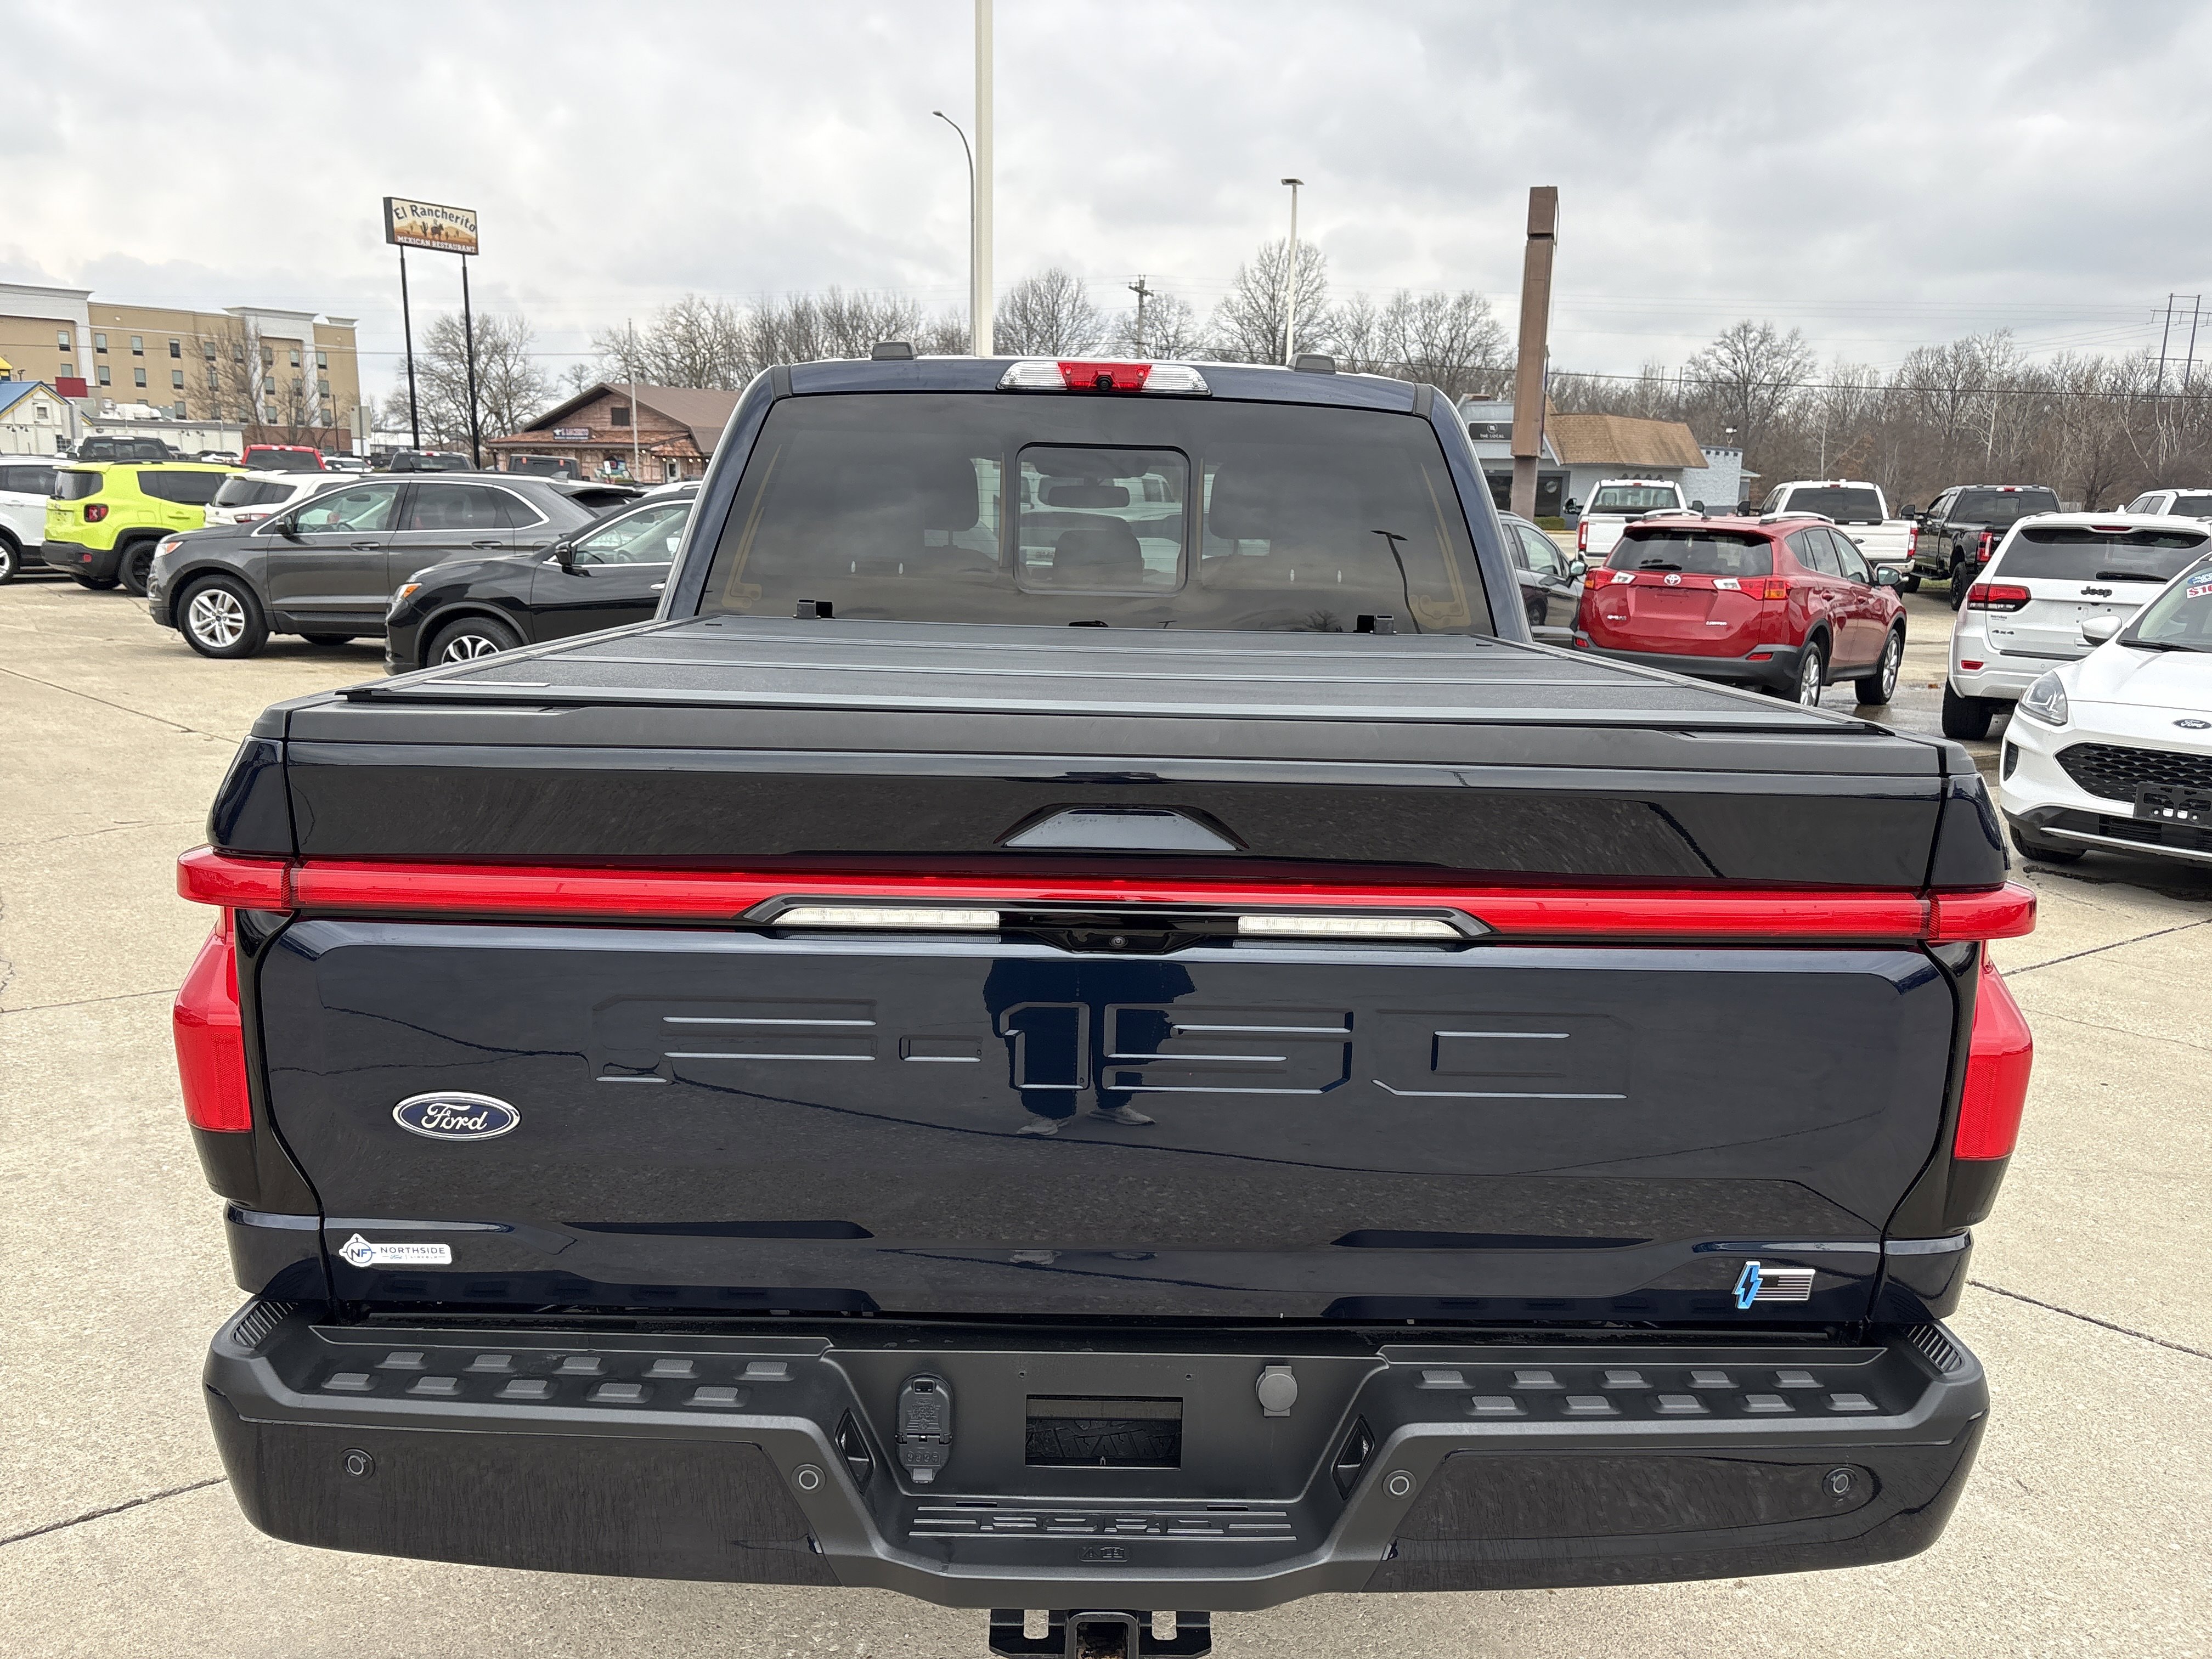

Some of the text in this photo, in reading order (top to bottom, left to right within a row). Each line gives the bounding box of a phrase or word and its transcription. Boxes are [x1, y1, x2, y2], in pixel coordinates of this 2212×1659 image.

[393, 204, 476, 233] El Rancherito
[397, 235, 476, 252] MEXICAN RESTAURANT
[2080, 586, 2112, 597] Jeep
[2180, 720, 2205, 728] Ford
[421, 1103, 488, 1130] Ford
[351, 1248, 372, 1261] NF
[980, 1515, 1224, 1534] FORD
